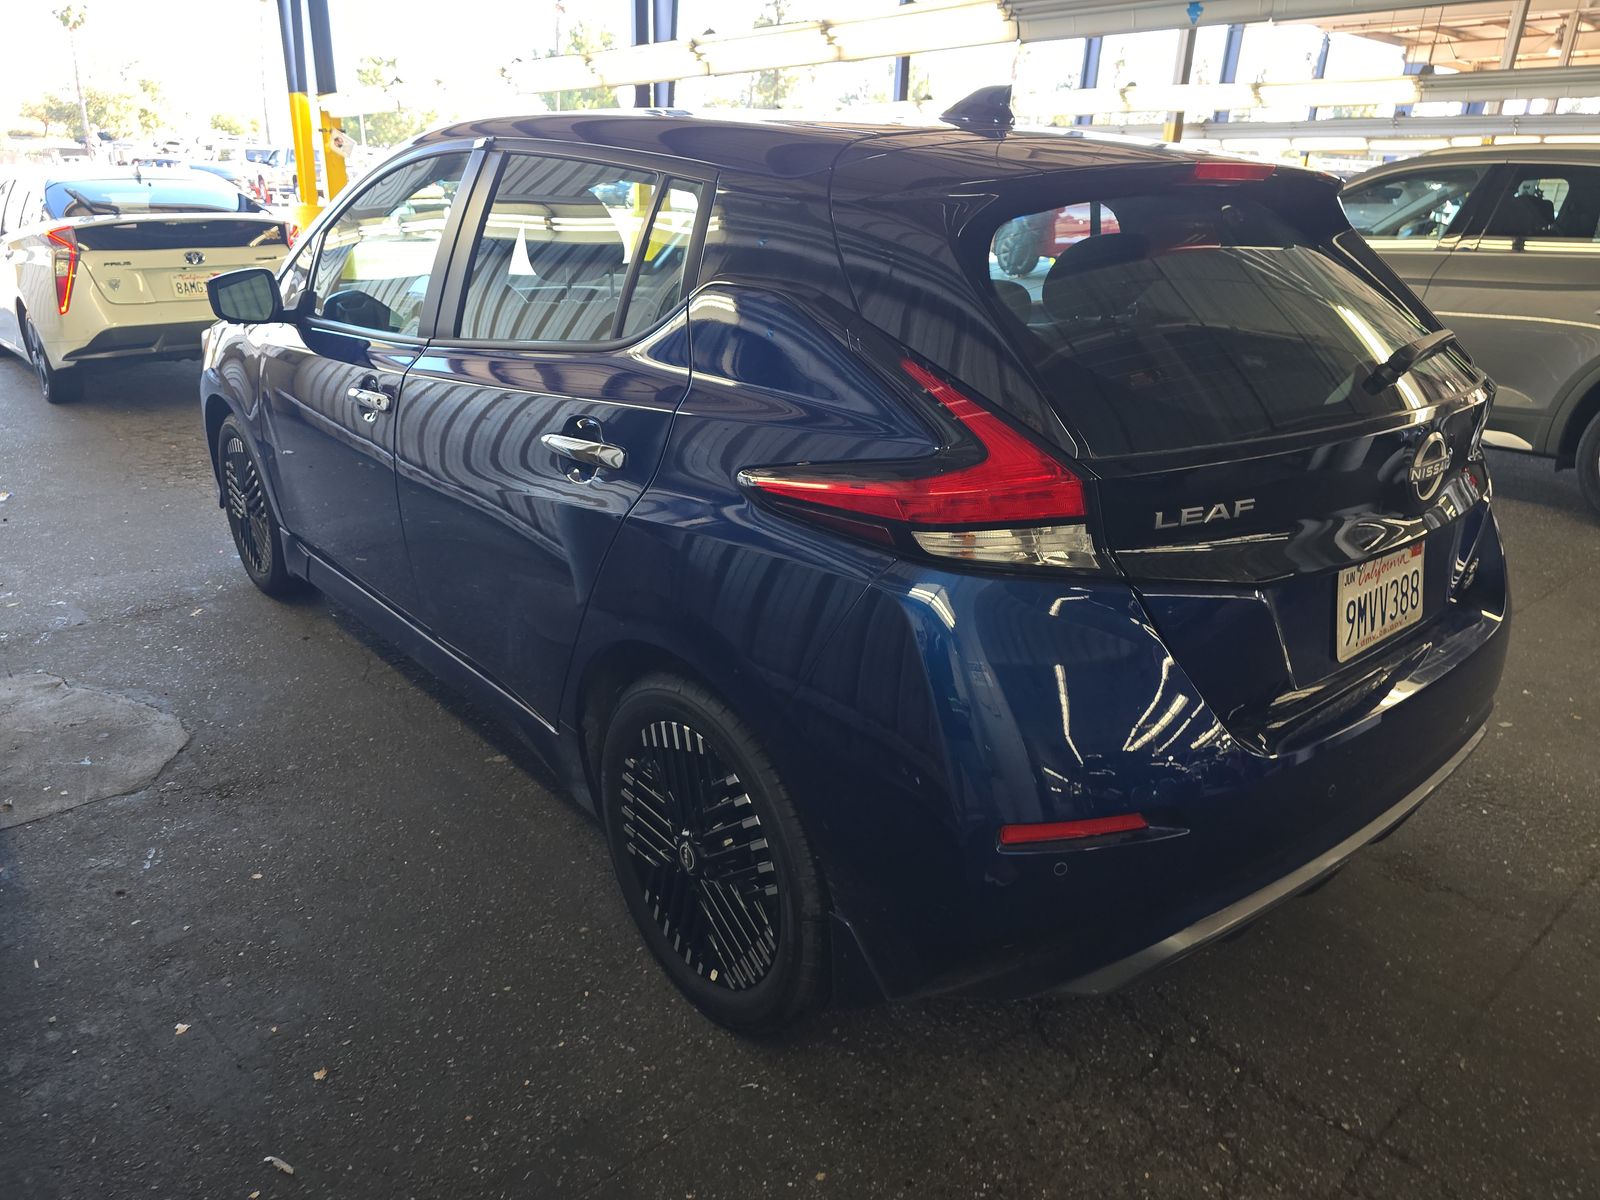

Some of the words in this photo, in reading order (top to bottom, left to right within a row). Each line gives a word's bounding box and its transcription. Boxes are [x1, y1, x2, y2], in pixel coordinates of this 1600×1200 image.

[1410, 458, 1452, 481] NISSAN
[1154, 498, 1256, 530] LEAF
[1343, 571, 1356, 587] JUN
[1358, 554, 1409, 586] California
[1345, 569, 1420, 647] 9MVV388
